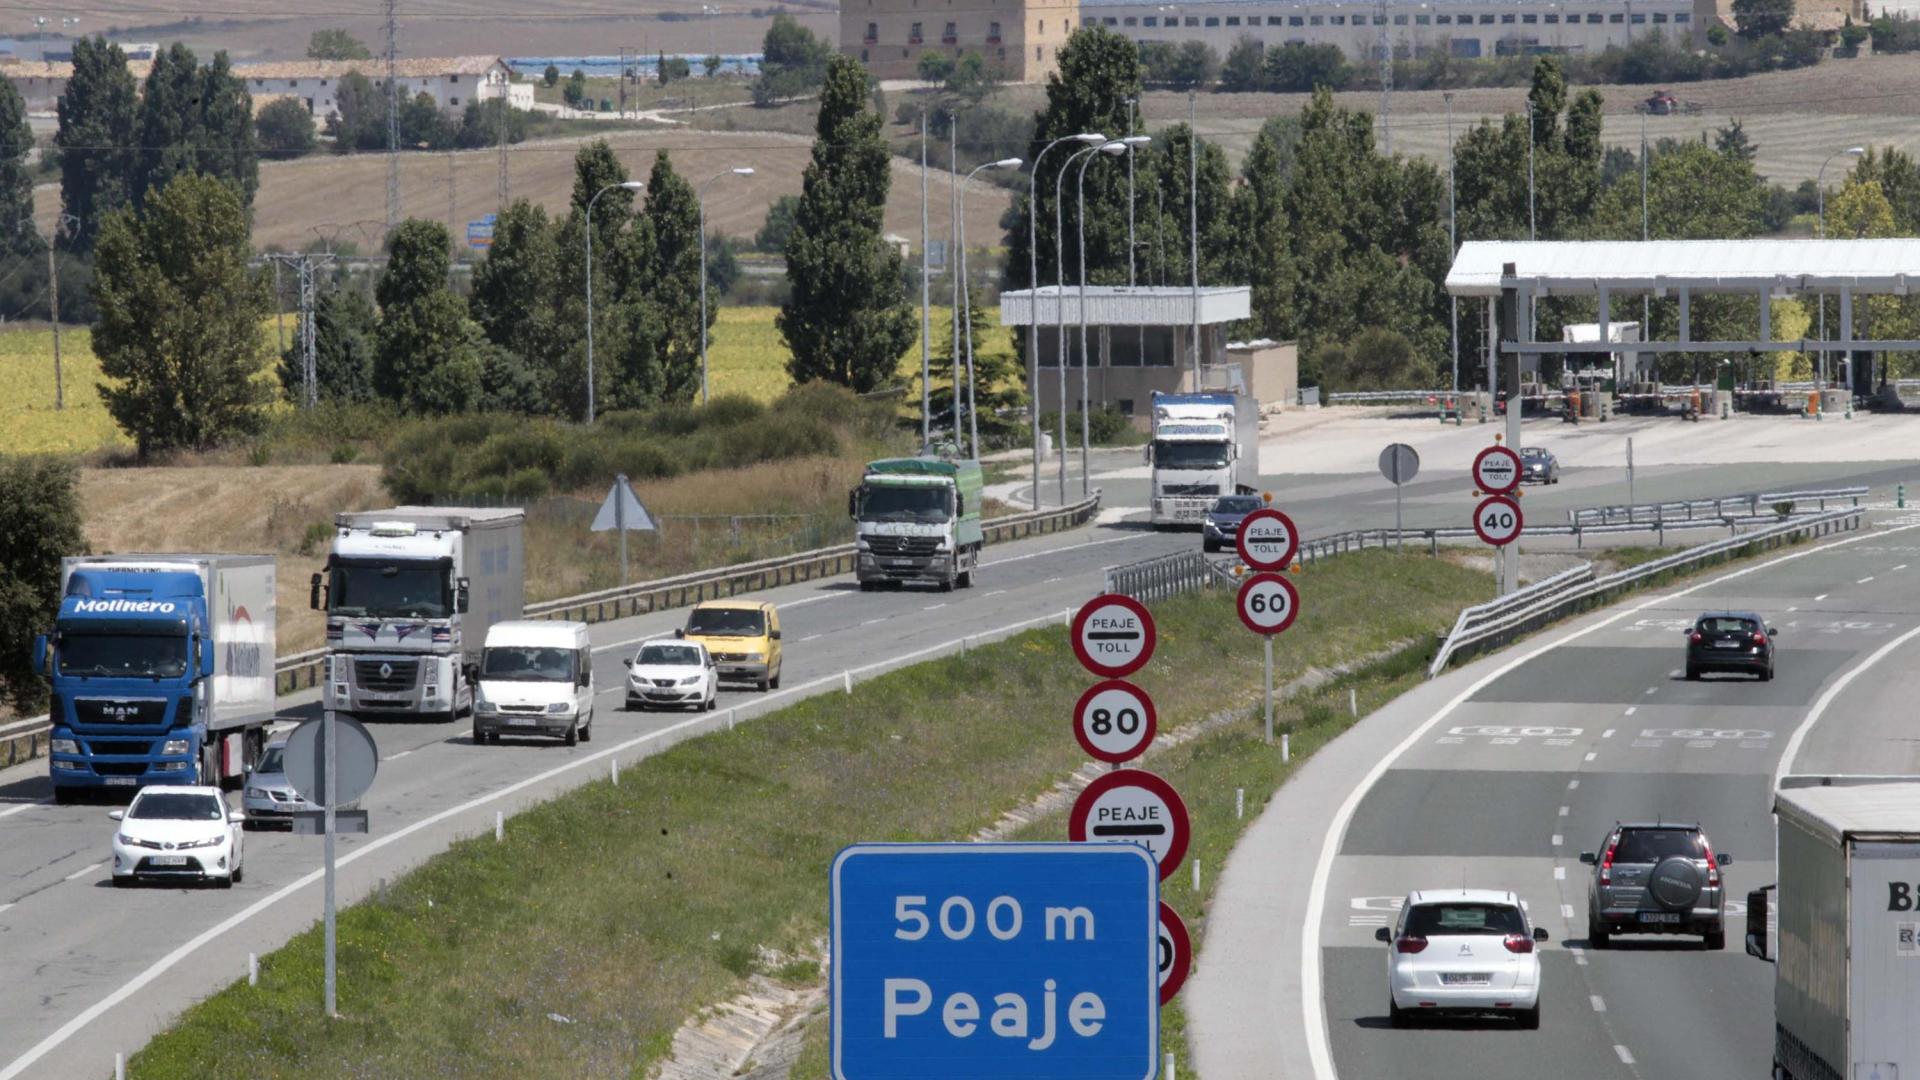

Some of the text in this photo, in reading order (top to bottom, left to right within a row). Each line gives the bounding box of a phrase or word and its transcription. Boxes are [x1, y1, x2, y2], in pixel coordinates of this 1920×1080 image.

[1489, 473, 1510, 481] TOLL
[1484, 512, 1513, 530] 40
[1250, 527, 1283, 537] PEAJE
[1253, 544, 1280, 554] TOLL
[74, 599, 175, 614] Molinero
[1250, 593, 1286, 614] 60
[1091, 618, 1135, 629] PEAJE
[1096, 642, 1131, 653] TOLL
[102, 706, 139, 715] MAN
[1091, 708, 1139, 735] 80
[1098, 805, 1160, 822] PEAJE
[894, 895, 1095, 941] 500 m
[884, 977, 1106, 1051] Peaje
